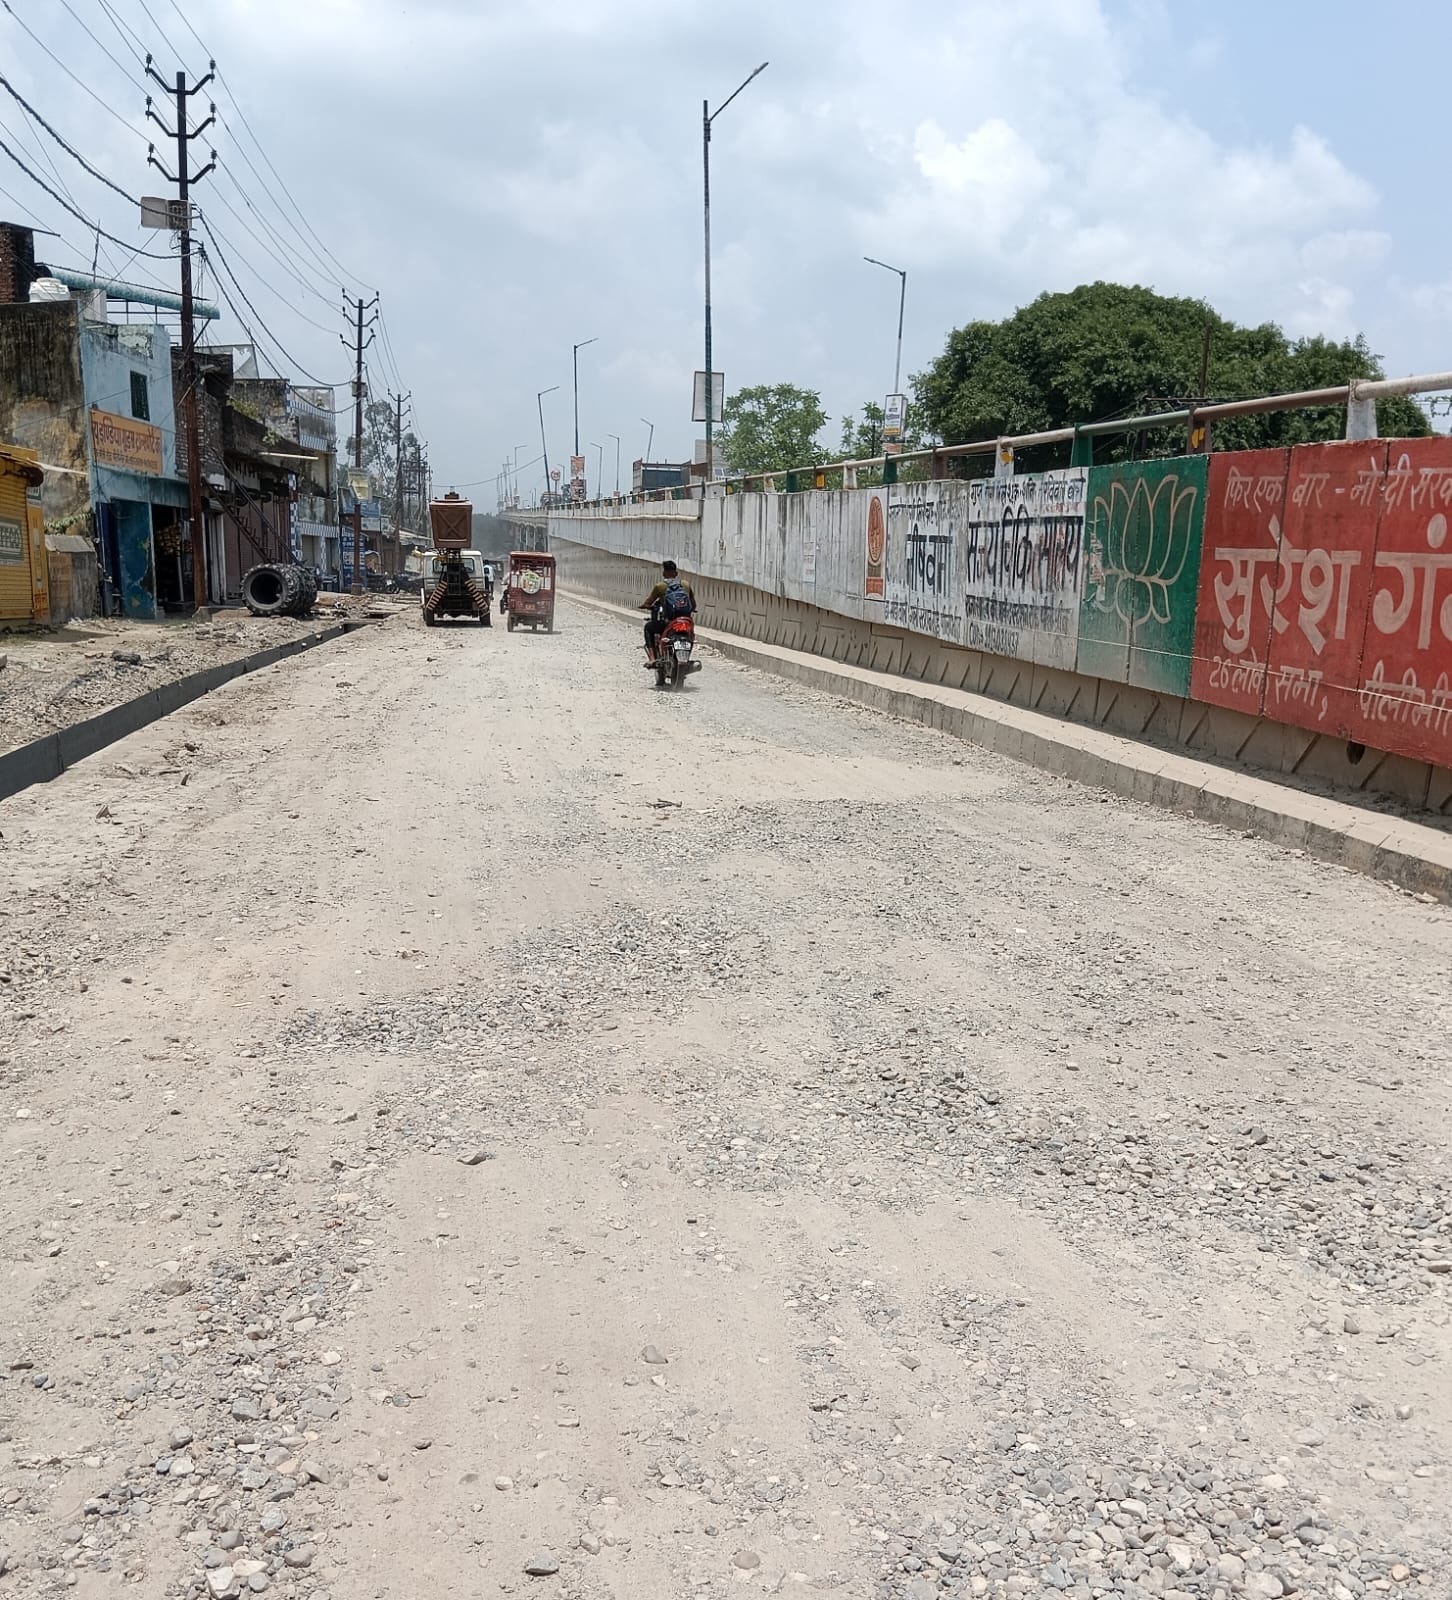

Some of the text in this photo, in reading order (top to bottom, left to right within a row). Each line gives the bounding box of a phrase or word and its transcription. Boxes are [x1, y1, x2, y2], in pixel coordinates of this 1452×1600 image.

[1224, 465, 1253, 509] फिर
[1253, 474, 1285, 513] एक
[1291, 472, 1330, 509] बार
[1214, 513, 1452, 656] सुरेश गं
[1209, 655, 1230, 689] 26
[1231, 647, 1271, 696] लोक
